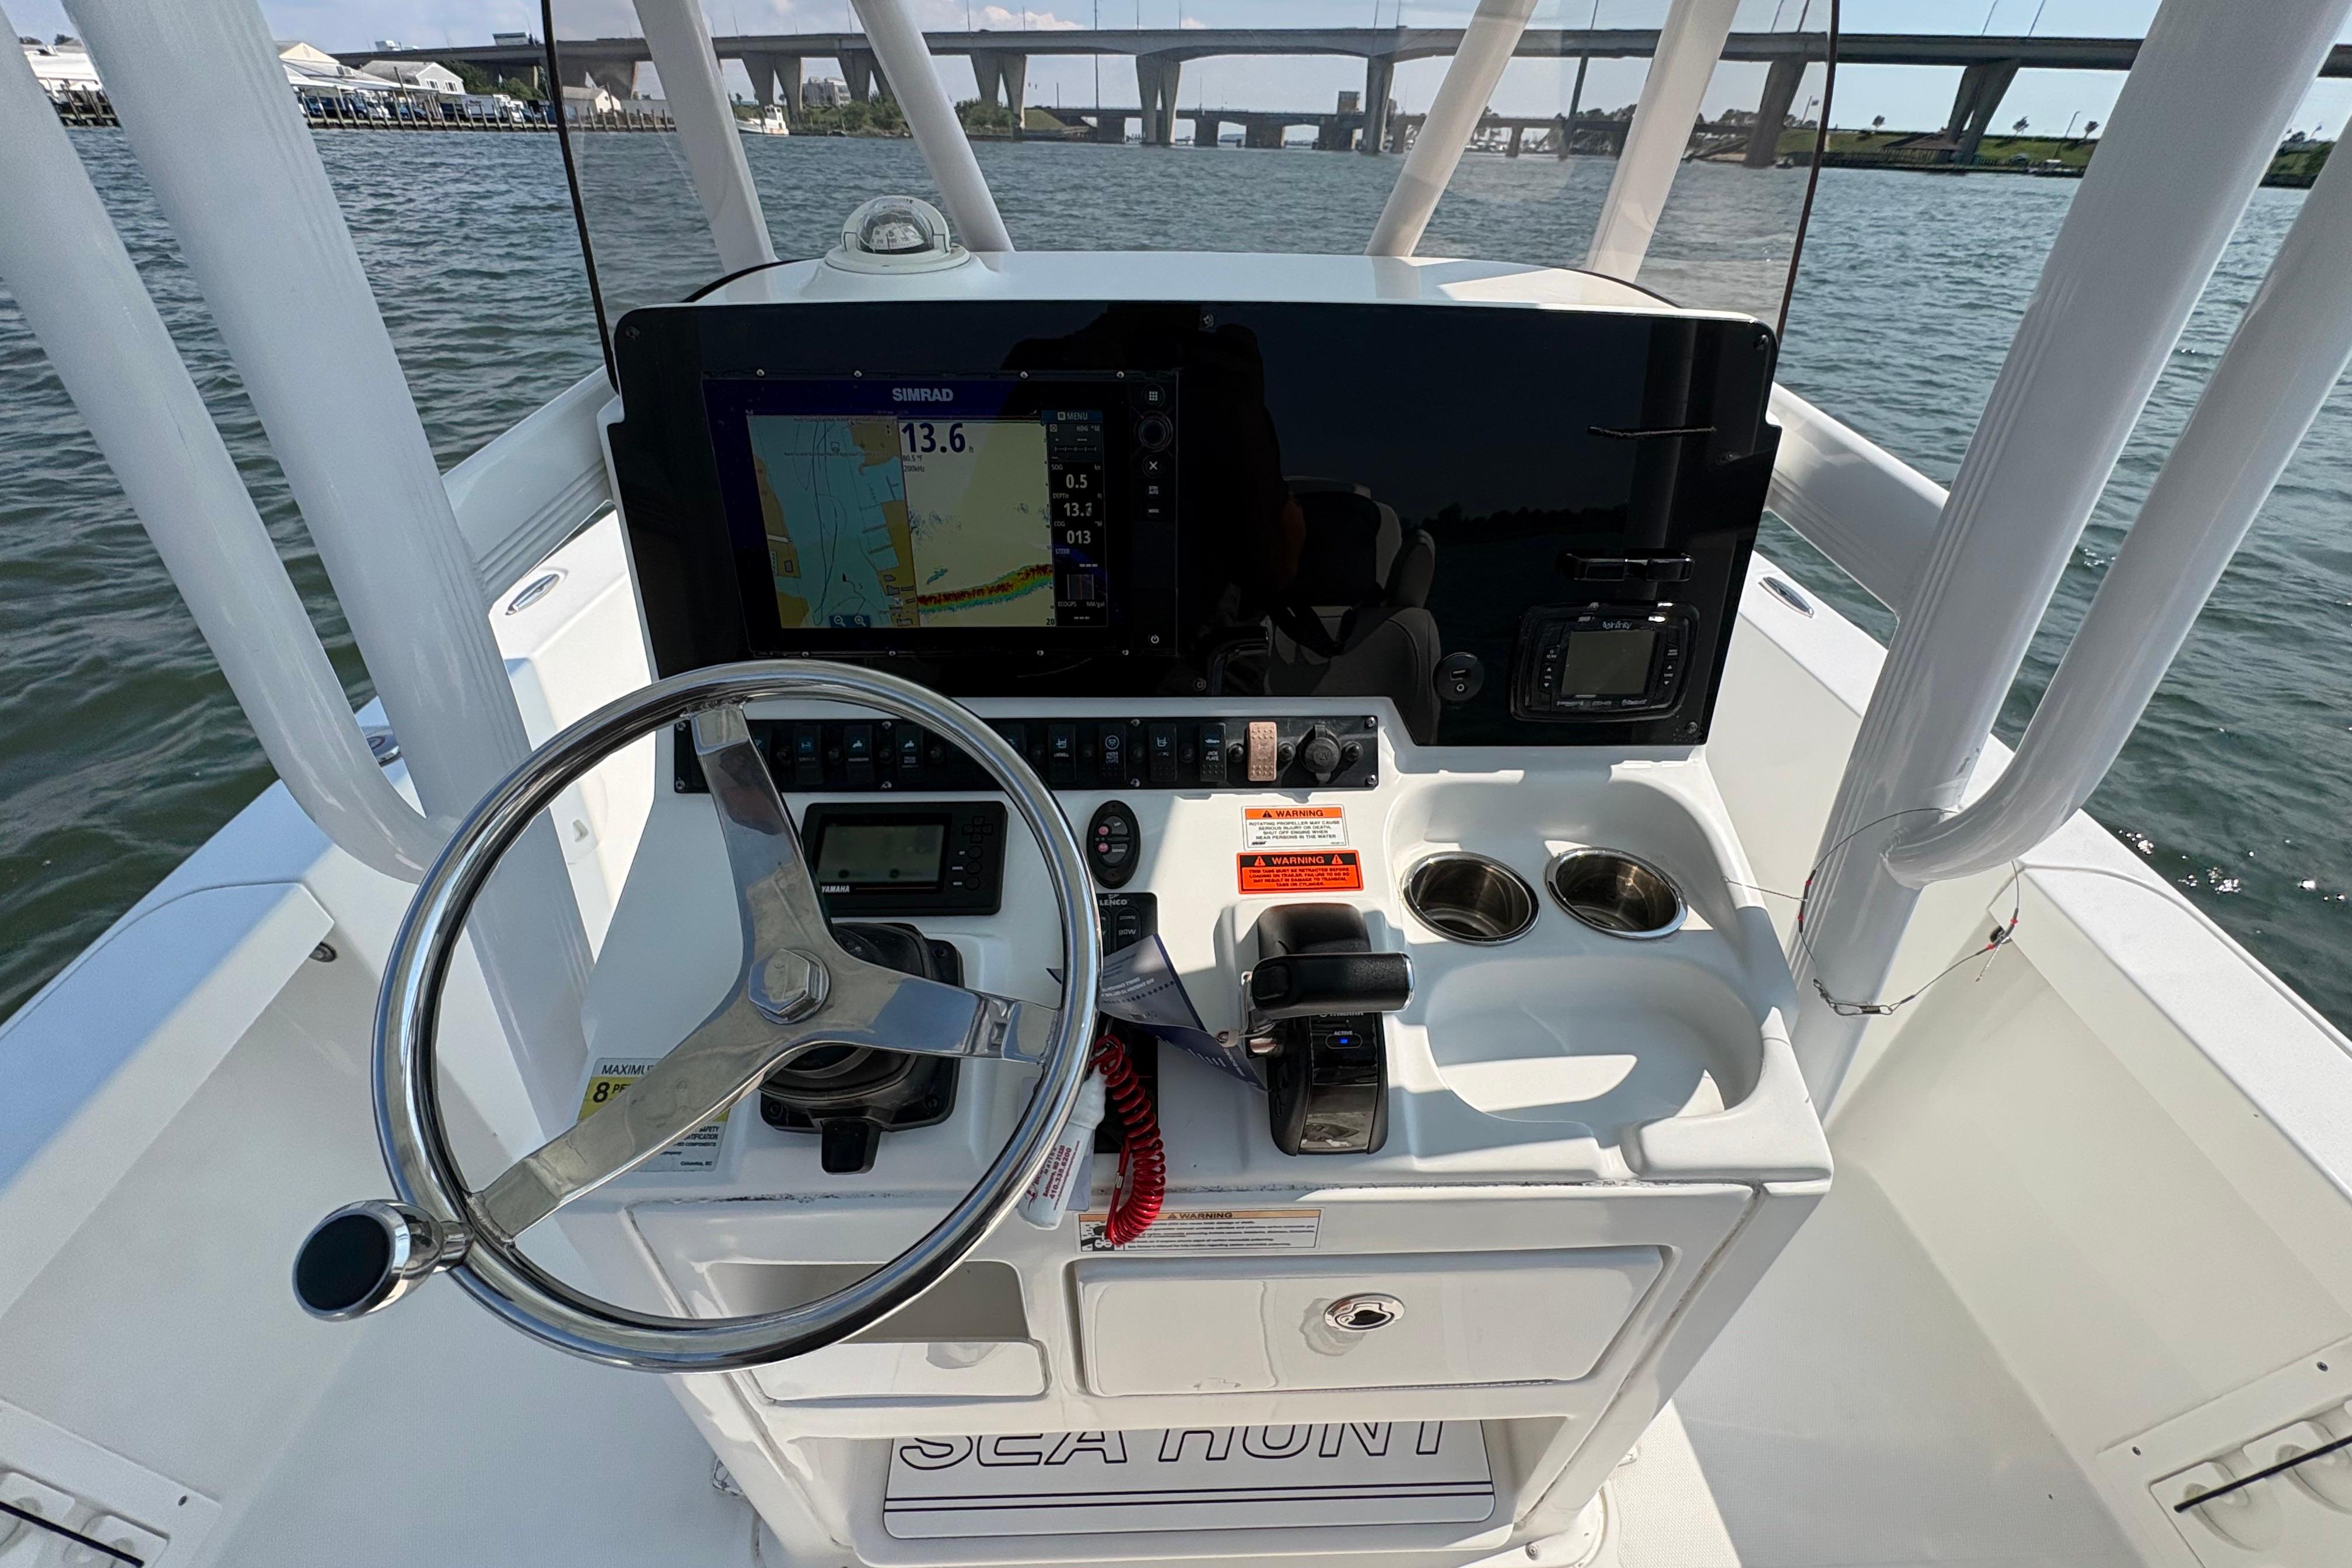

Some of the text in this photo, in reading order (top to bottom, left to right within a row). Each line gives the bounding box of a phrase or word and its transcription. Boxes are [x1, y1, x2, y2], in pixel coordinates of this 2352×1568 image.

[892, 387, 954, 402] SIMRAD
[1066, 412, 1088, 421] MENU
[901, 422, 966, 453] 13.6
[1066, 473, 1088, 489] 0.5
[1066, 530, 1091, 544] 013
[1275, 809, 1324, 817] WARNING
[1271, 856, 1325, 864] WARNING
[821, 884, 850, 893] YAMAHA
[1118, 928, 1136, 936] BOW
[601, 1065, 653, 1074] MAXIMU
[593, 1082, 610, 1103] 8
[1049, 1147, 1072, 1199] 410.335.6200
